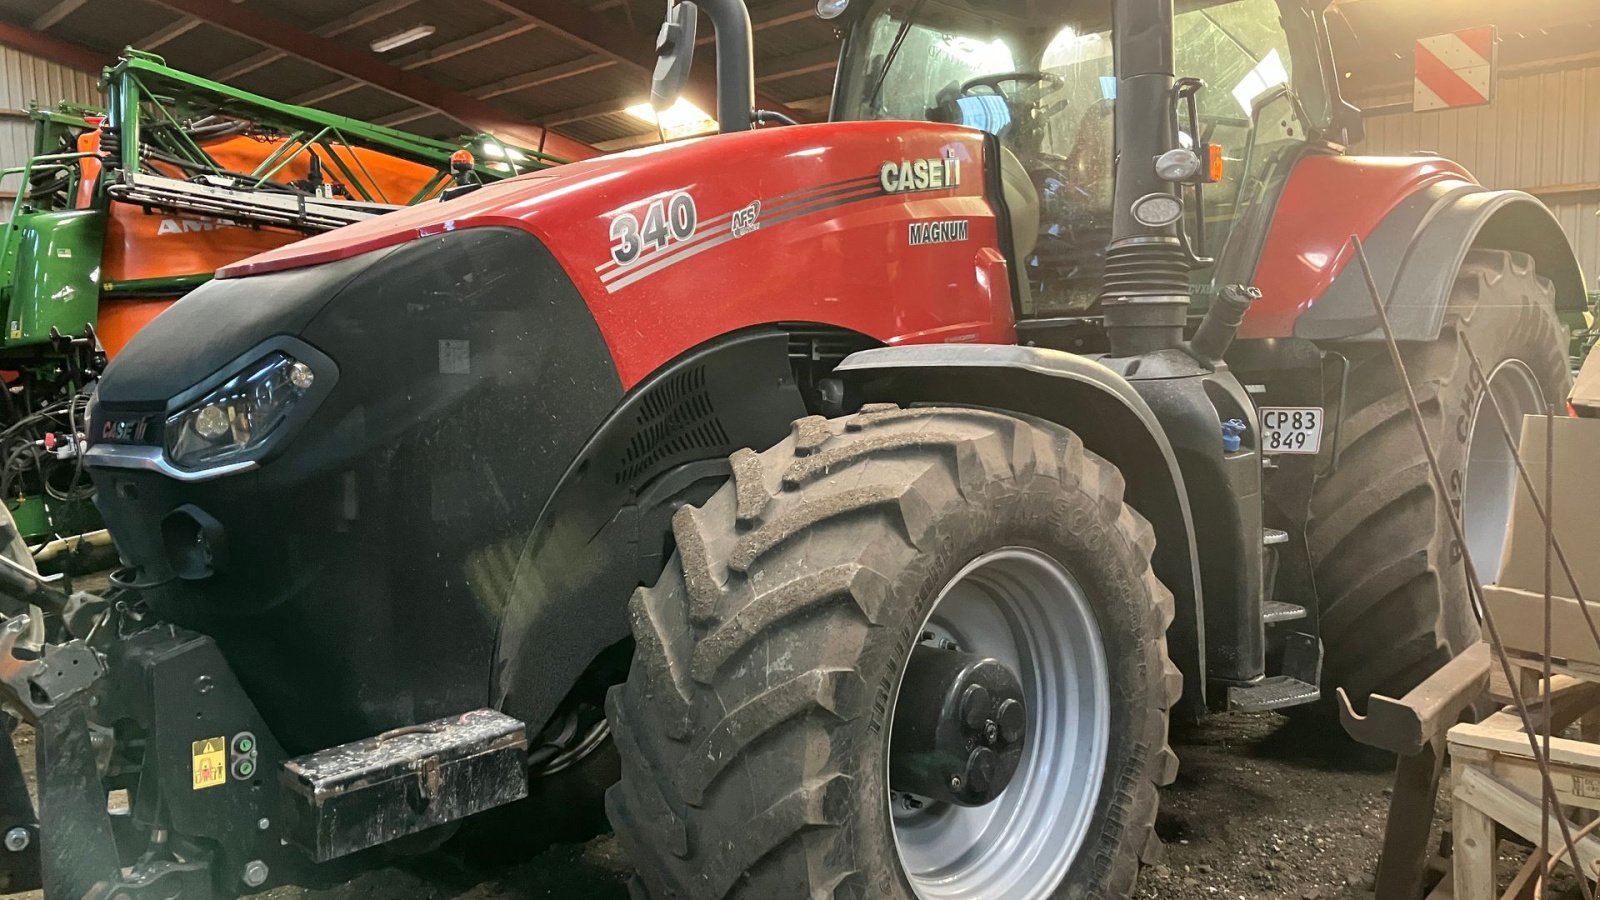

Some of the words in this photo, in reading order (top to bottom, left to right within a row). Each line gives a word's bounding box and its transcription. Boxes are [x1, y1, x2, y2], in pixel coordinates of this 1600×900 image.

[881, 159, 942, 192] CASE
[610, 191, 697, 266] 340
[732, 205, 755, 231] AFS
[909, 220, 968, 245] MAGNUM
[1270, 431, 1306, 449] 849
